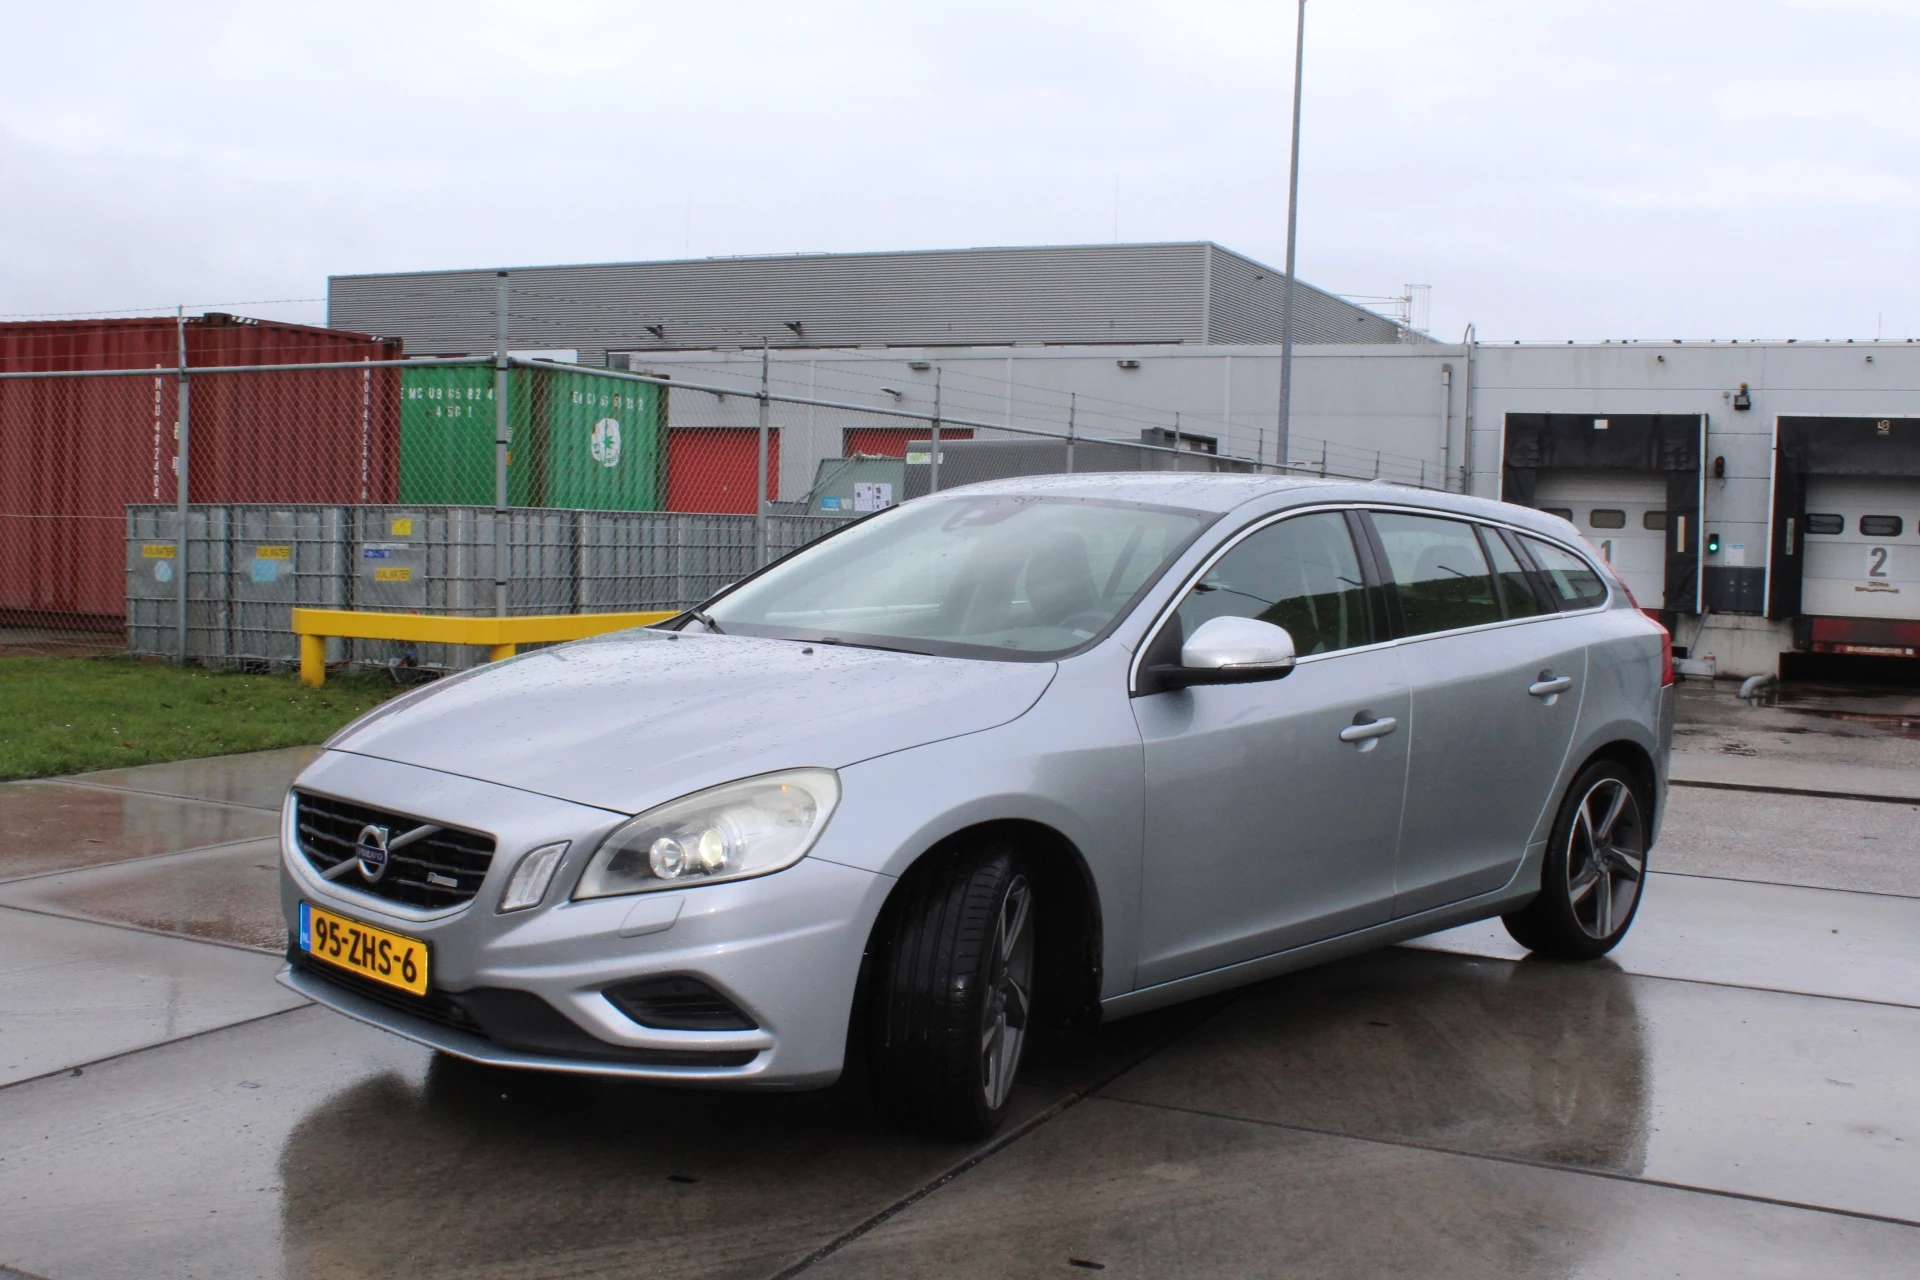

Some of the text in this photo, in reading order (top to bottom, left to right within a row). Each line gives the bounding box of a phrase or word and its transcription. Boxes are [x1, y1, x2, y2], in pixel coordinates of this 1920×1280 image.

[1601, 540, 1611, 564] 1
[1869, 547, 1887, 577] 2
[358, 848, 383, 861] VOLVO
[316, 917, 417, 983] 95-ZHS-6
